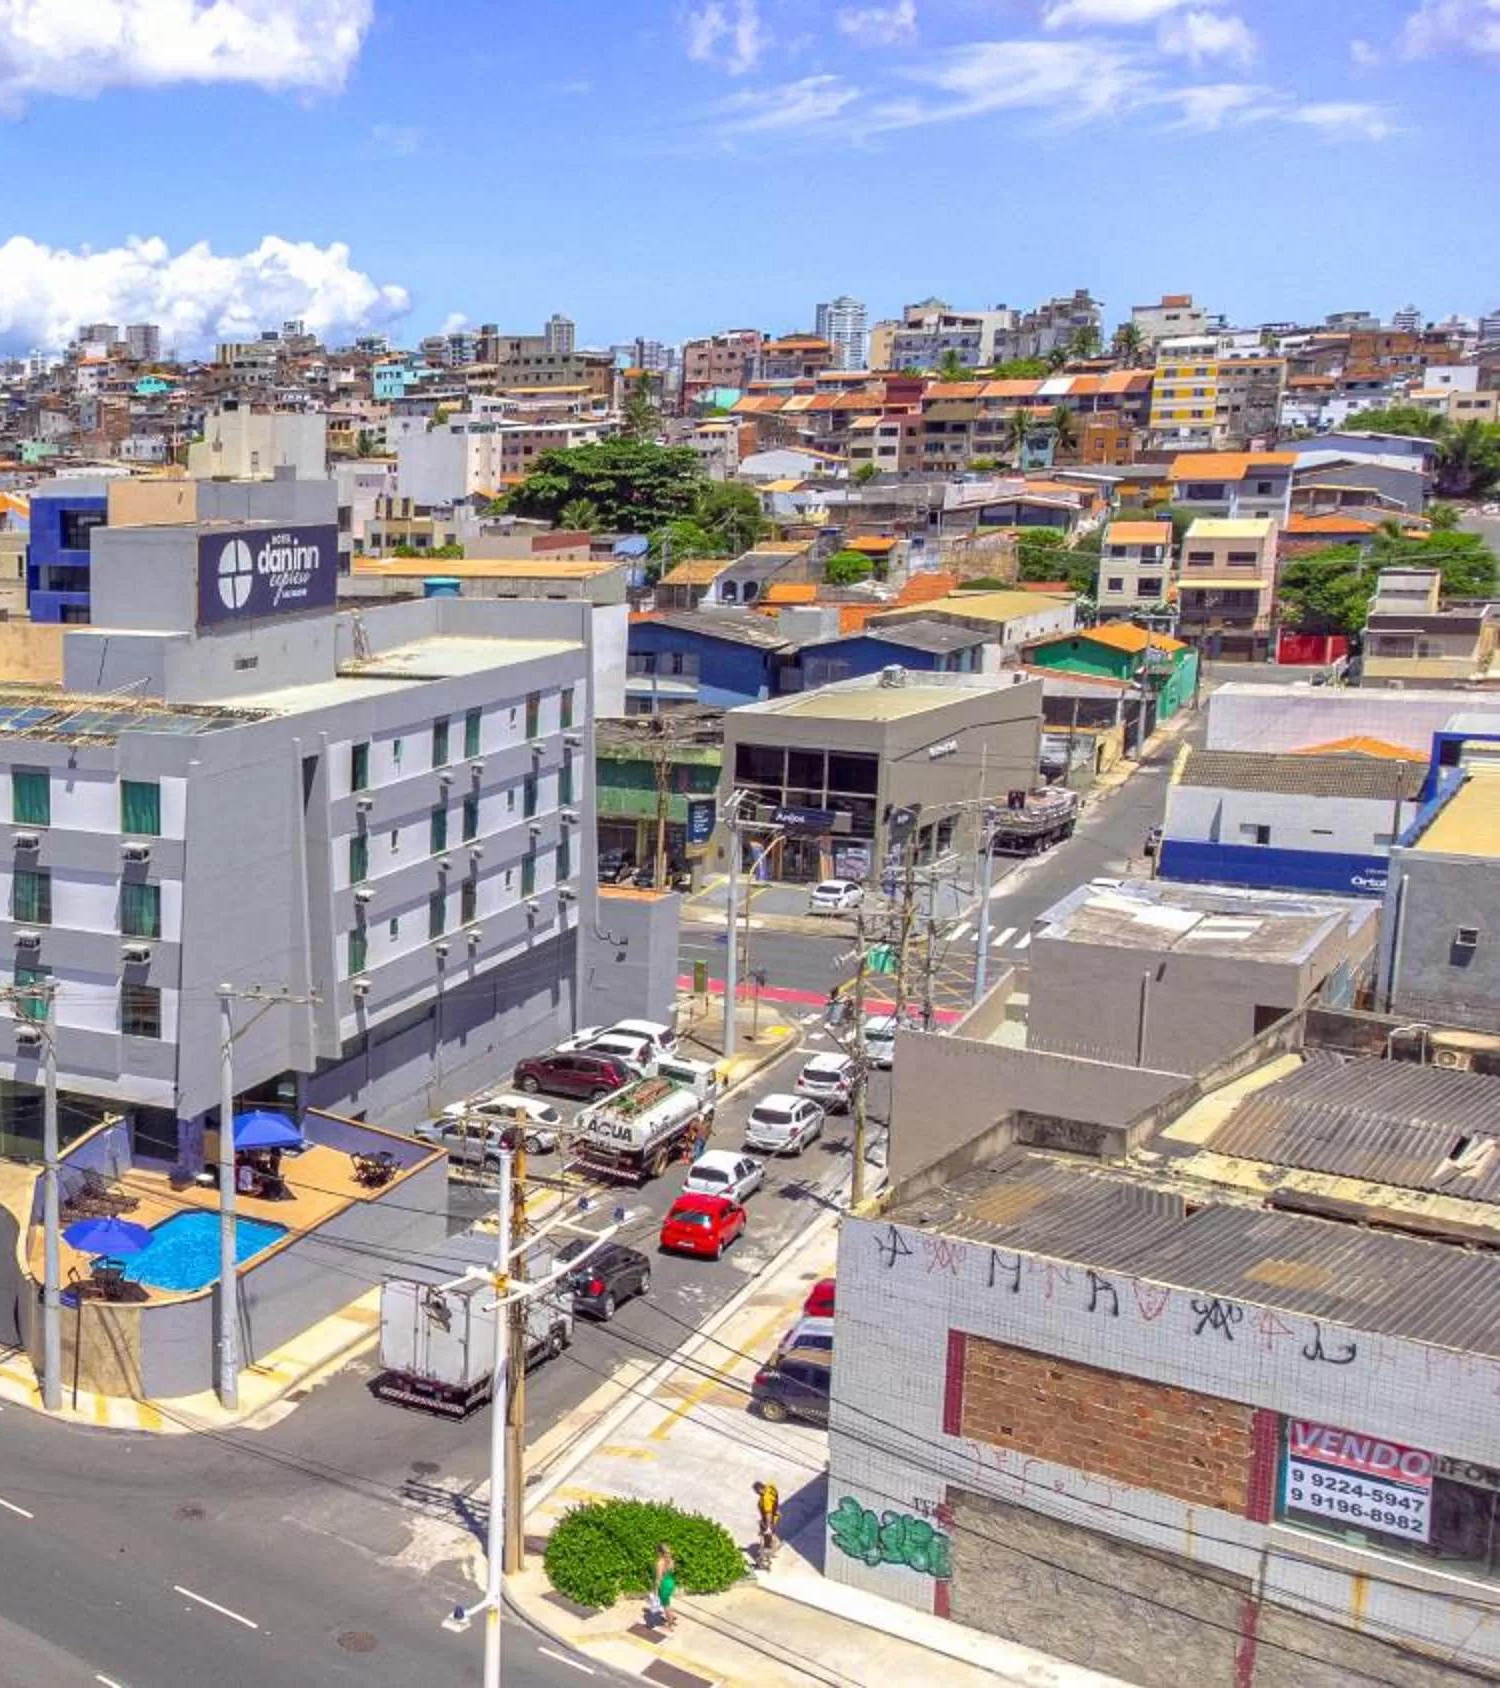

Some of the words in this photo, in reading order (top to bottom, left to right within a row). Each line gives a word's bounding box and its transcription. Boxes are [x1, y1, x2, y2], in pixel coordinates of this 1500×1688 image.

[1294, 1423, 1431, 1477] VENDO
[1291, 1487, 1304, 1501] 9
[1311, 1492, 1424, 1534] 9196-8982
[1292, 1468, 1305, 1482] 9
[1311, 1472, 1425, 1513] 9224-5947
